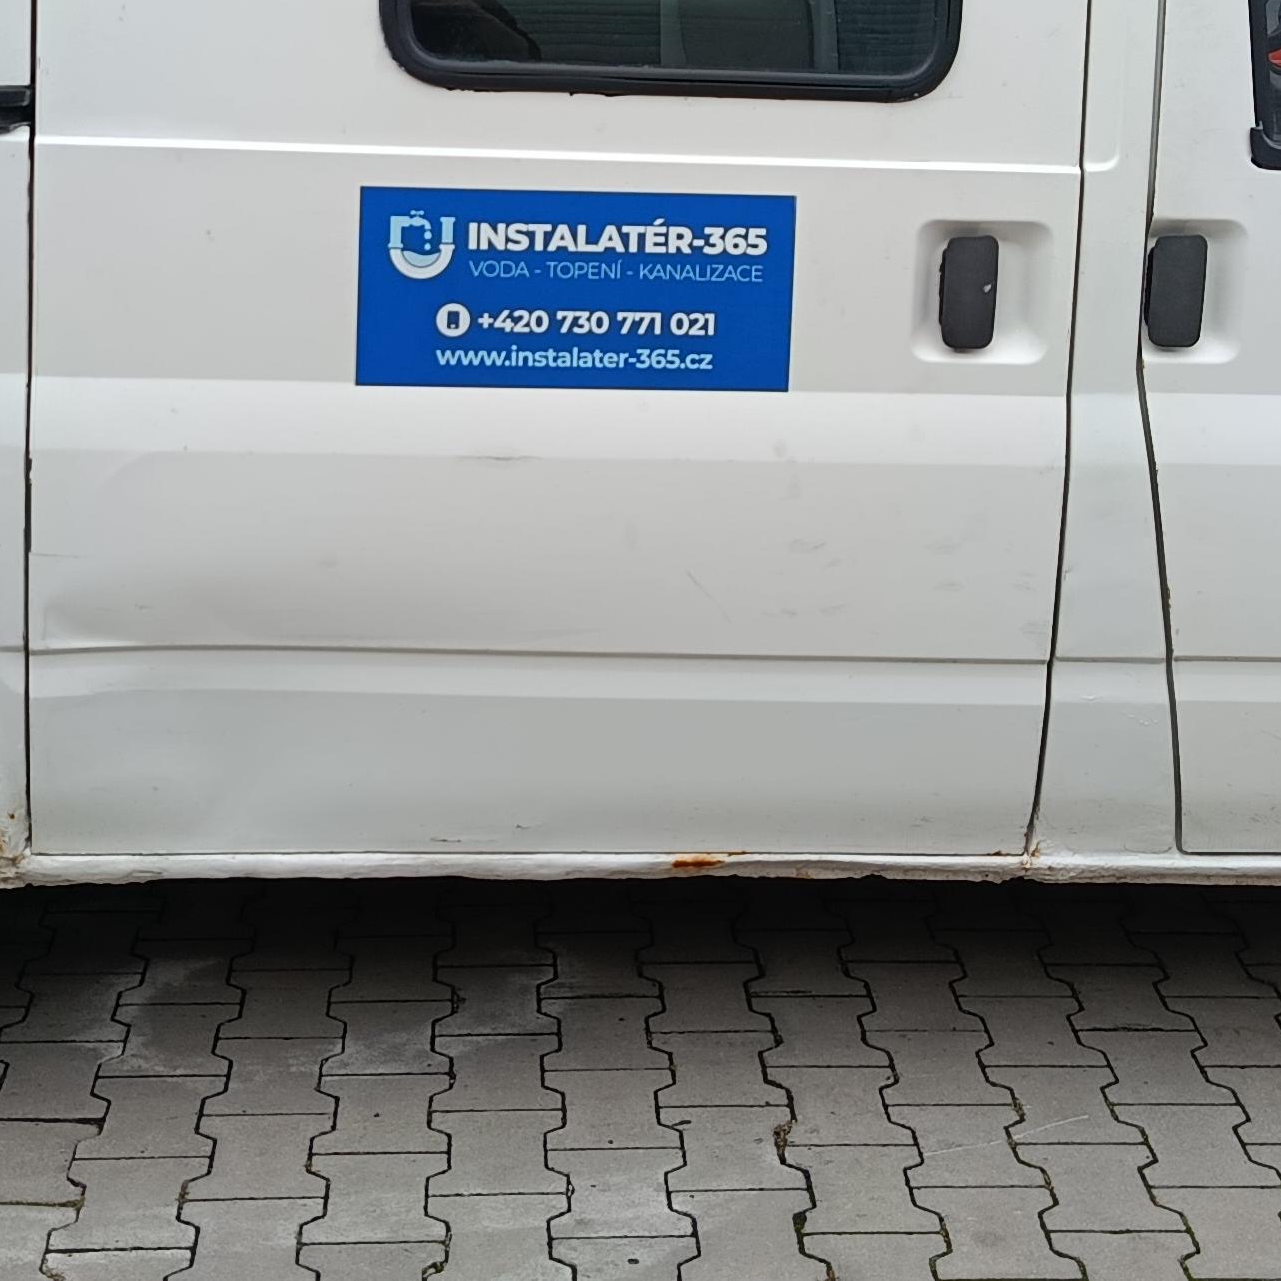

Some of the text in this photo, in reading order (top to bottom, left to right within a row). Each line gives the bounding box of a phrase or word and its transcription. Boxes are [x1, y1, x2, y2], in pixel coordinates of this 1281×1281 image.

[468, 218, 768, 256] INSTALATÉR-365
[468, 260, 530, 279] VODA
[546, 260, 622, 281] TOPENÍ
[639, 263, 764, 283] KANALIZACE
[477, 309, 715, 336] +420 730 771 021
[435, 345, 713, 370] www.instalater-365.cz
